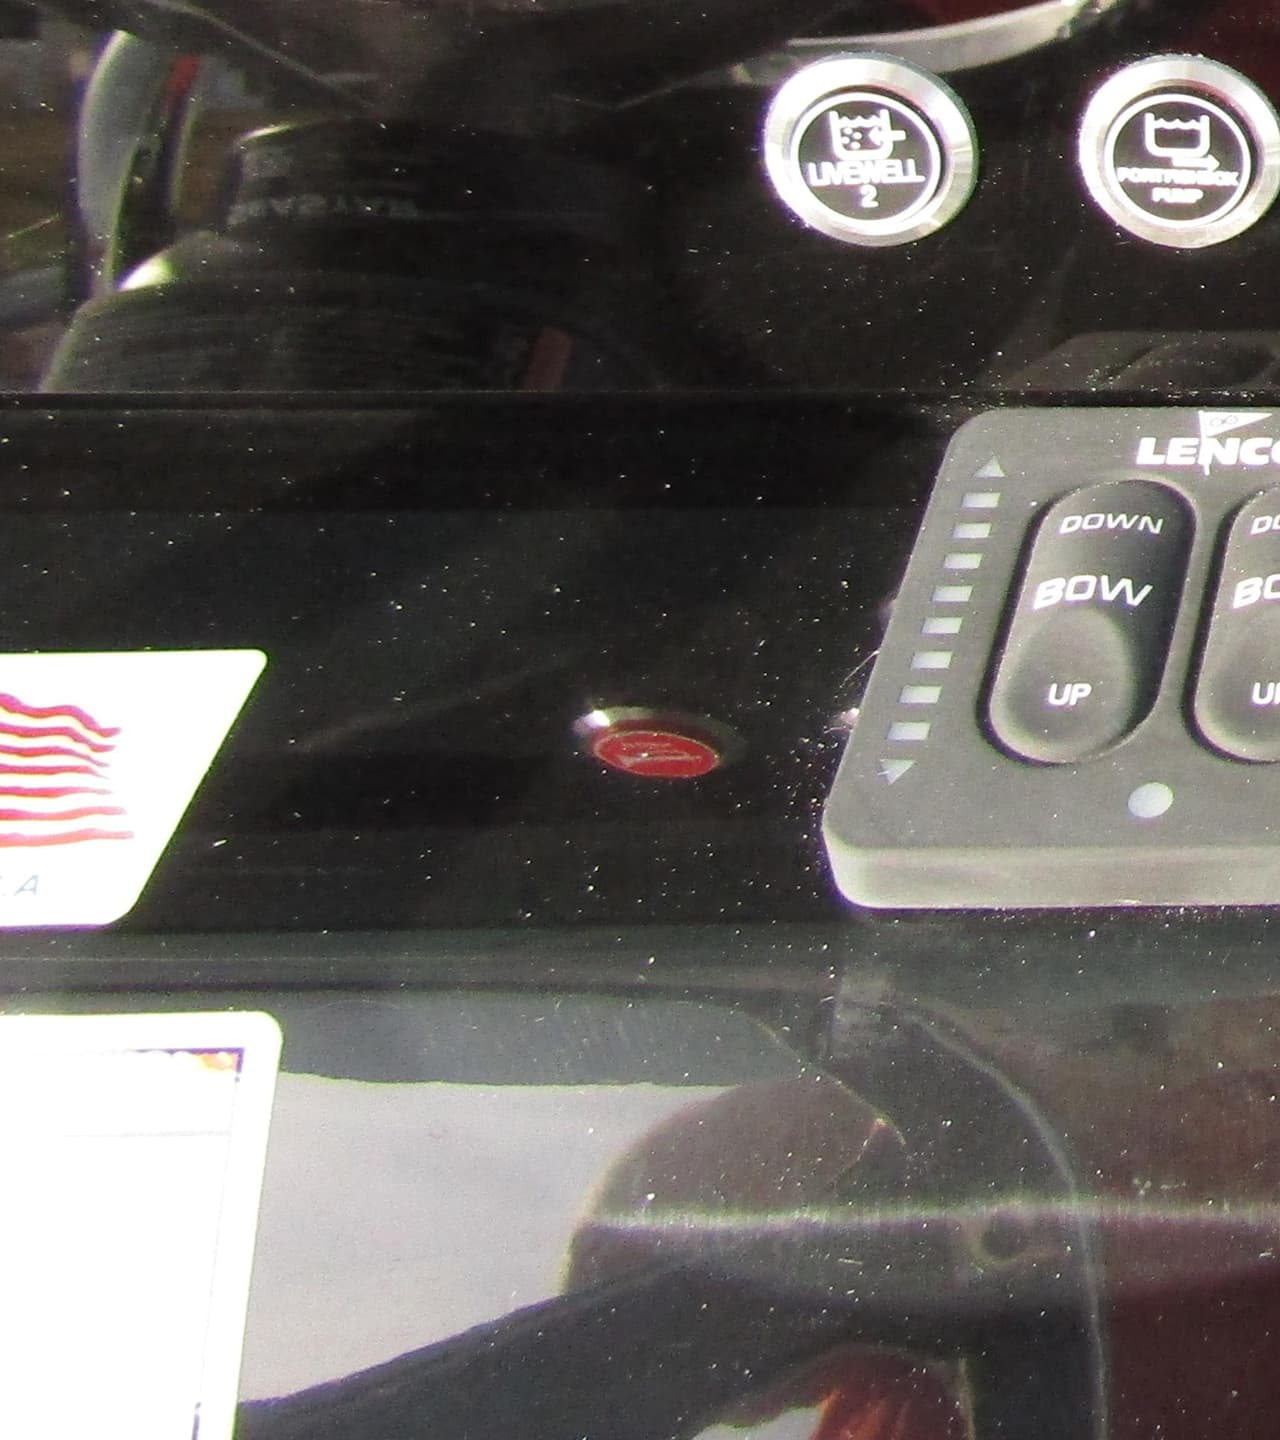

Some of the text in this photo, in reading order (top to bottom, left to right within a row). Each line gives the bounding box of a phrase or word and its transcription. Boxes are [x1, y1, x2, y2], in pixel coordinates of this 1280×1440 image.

[808, 159, 926, 187] LIVEWELL
[860, 185, 879, 208] 2
[1059, 513, 1164, 535] DOWN
[1033, 574, 1153, 611] BOW
[1048, 682, 1092, 707] UP
